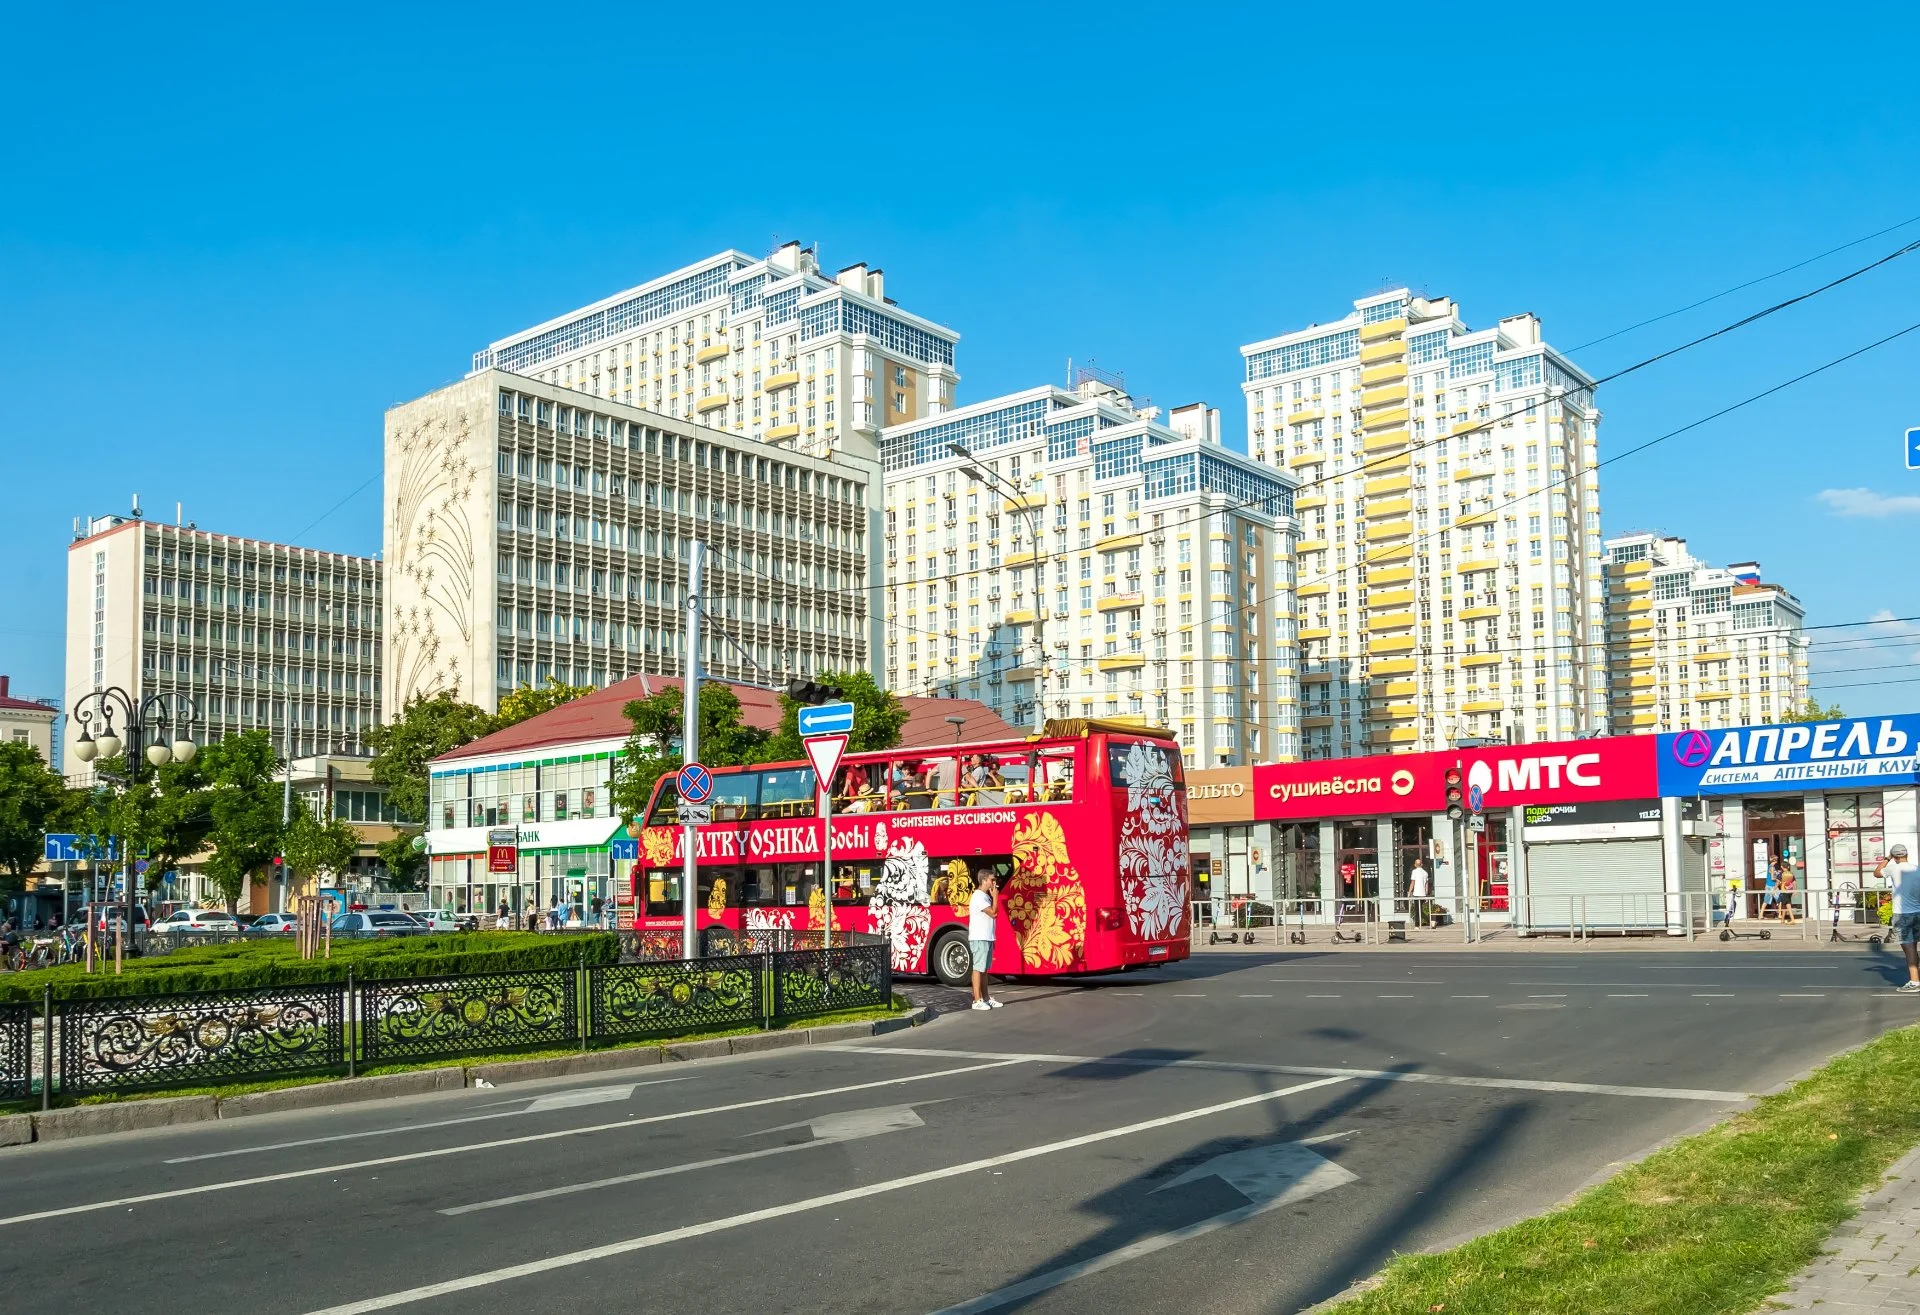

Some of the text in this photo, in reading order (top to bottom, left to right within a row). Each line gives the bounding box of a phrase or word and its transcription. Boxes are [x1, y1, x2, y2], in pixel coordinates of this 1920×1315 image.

[1710, 719, 1908, 766] АПРЕЛЬ
[1498, 753, 1601, 792] МТС
[1706, 771, 1759, 784] СИСТЕМА
[1774, 759, 1868, 780] АПТЕЧНЫЙ
[1187, 783, 1244, 799] альто
[1270, 776, 1381, 802] сушивёсла
[1526, 806, 1576, 815] ПОДКЛЮЧИМ
[1639, 808, 1660, 819] TELE2
[892, 811, 1016, 828] SIGHTSEEING EXCURSIONS
[1526, 815, 1552, 824] ЗДЕСЬ
[518, 831, 540, 843] БАНК
